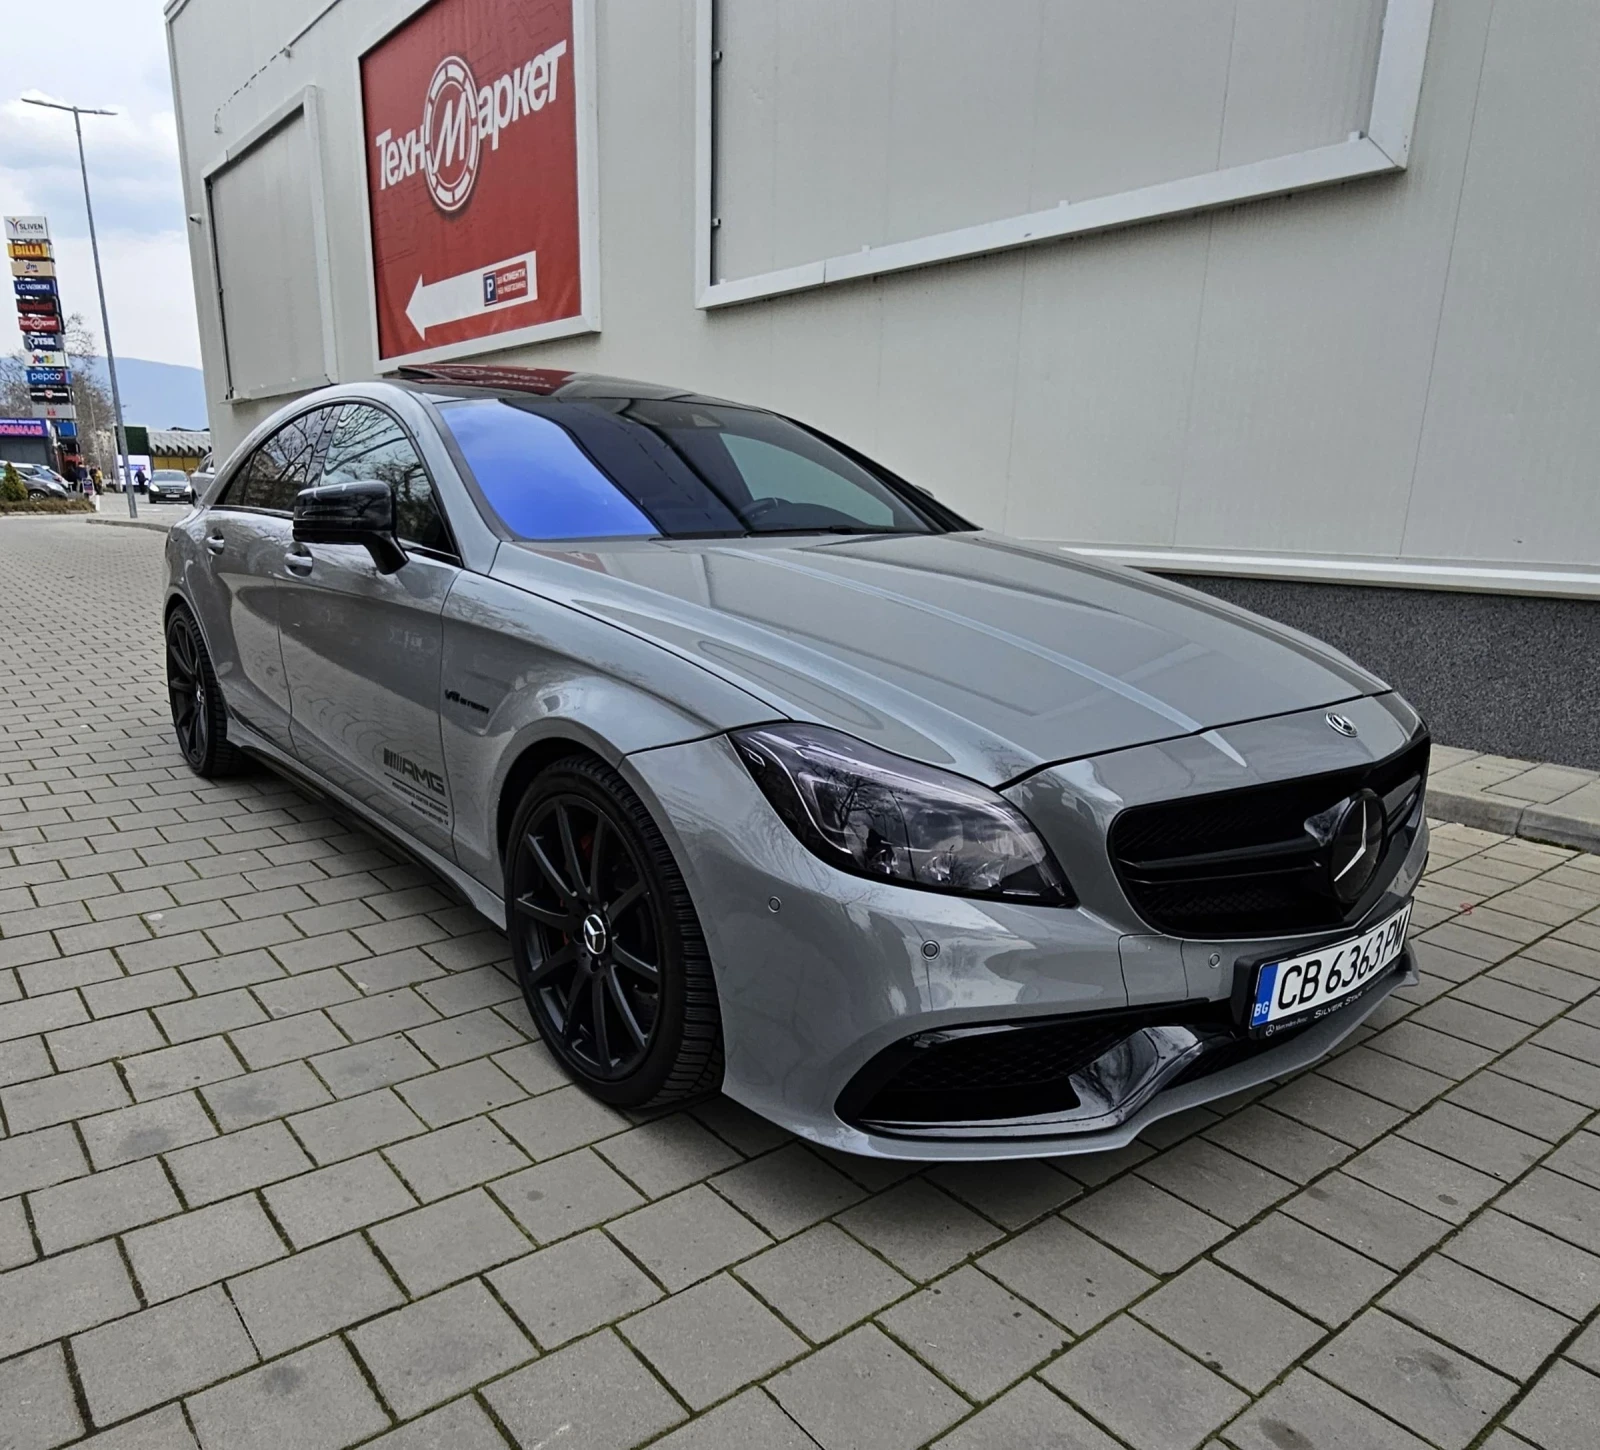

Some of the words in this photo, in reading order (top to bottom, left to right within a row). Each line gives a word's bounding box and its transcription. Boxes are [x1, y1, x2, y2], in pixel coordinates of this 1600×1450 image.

[19, 223, 44, 231] SLIVEN
[15, 245, 42, 255] BILLA
[486, 279, 494, 299] P
[34, 337, 55, 346] JYSK
[31, 372, 61, 381] pepco
[1277, 959, 1322, 1010] CB
[1325, 930, 1385, 994] 6363
[1253, 1002, 1269, 1018] BG
